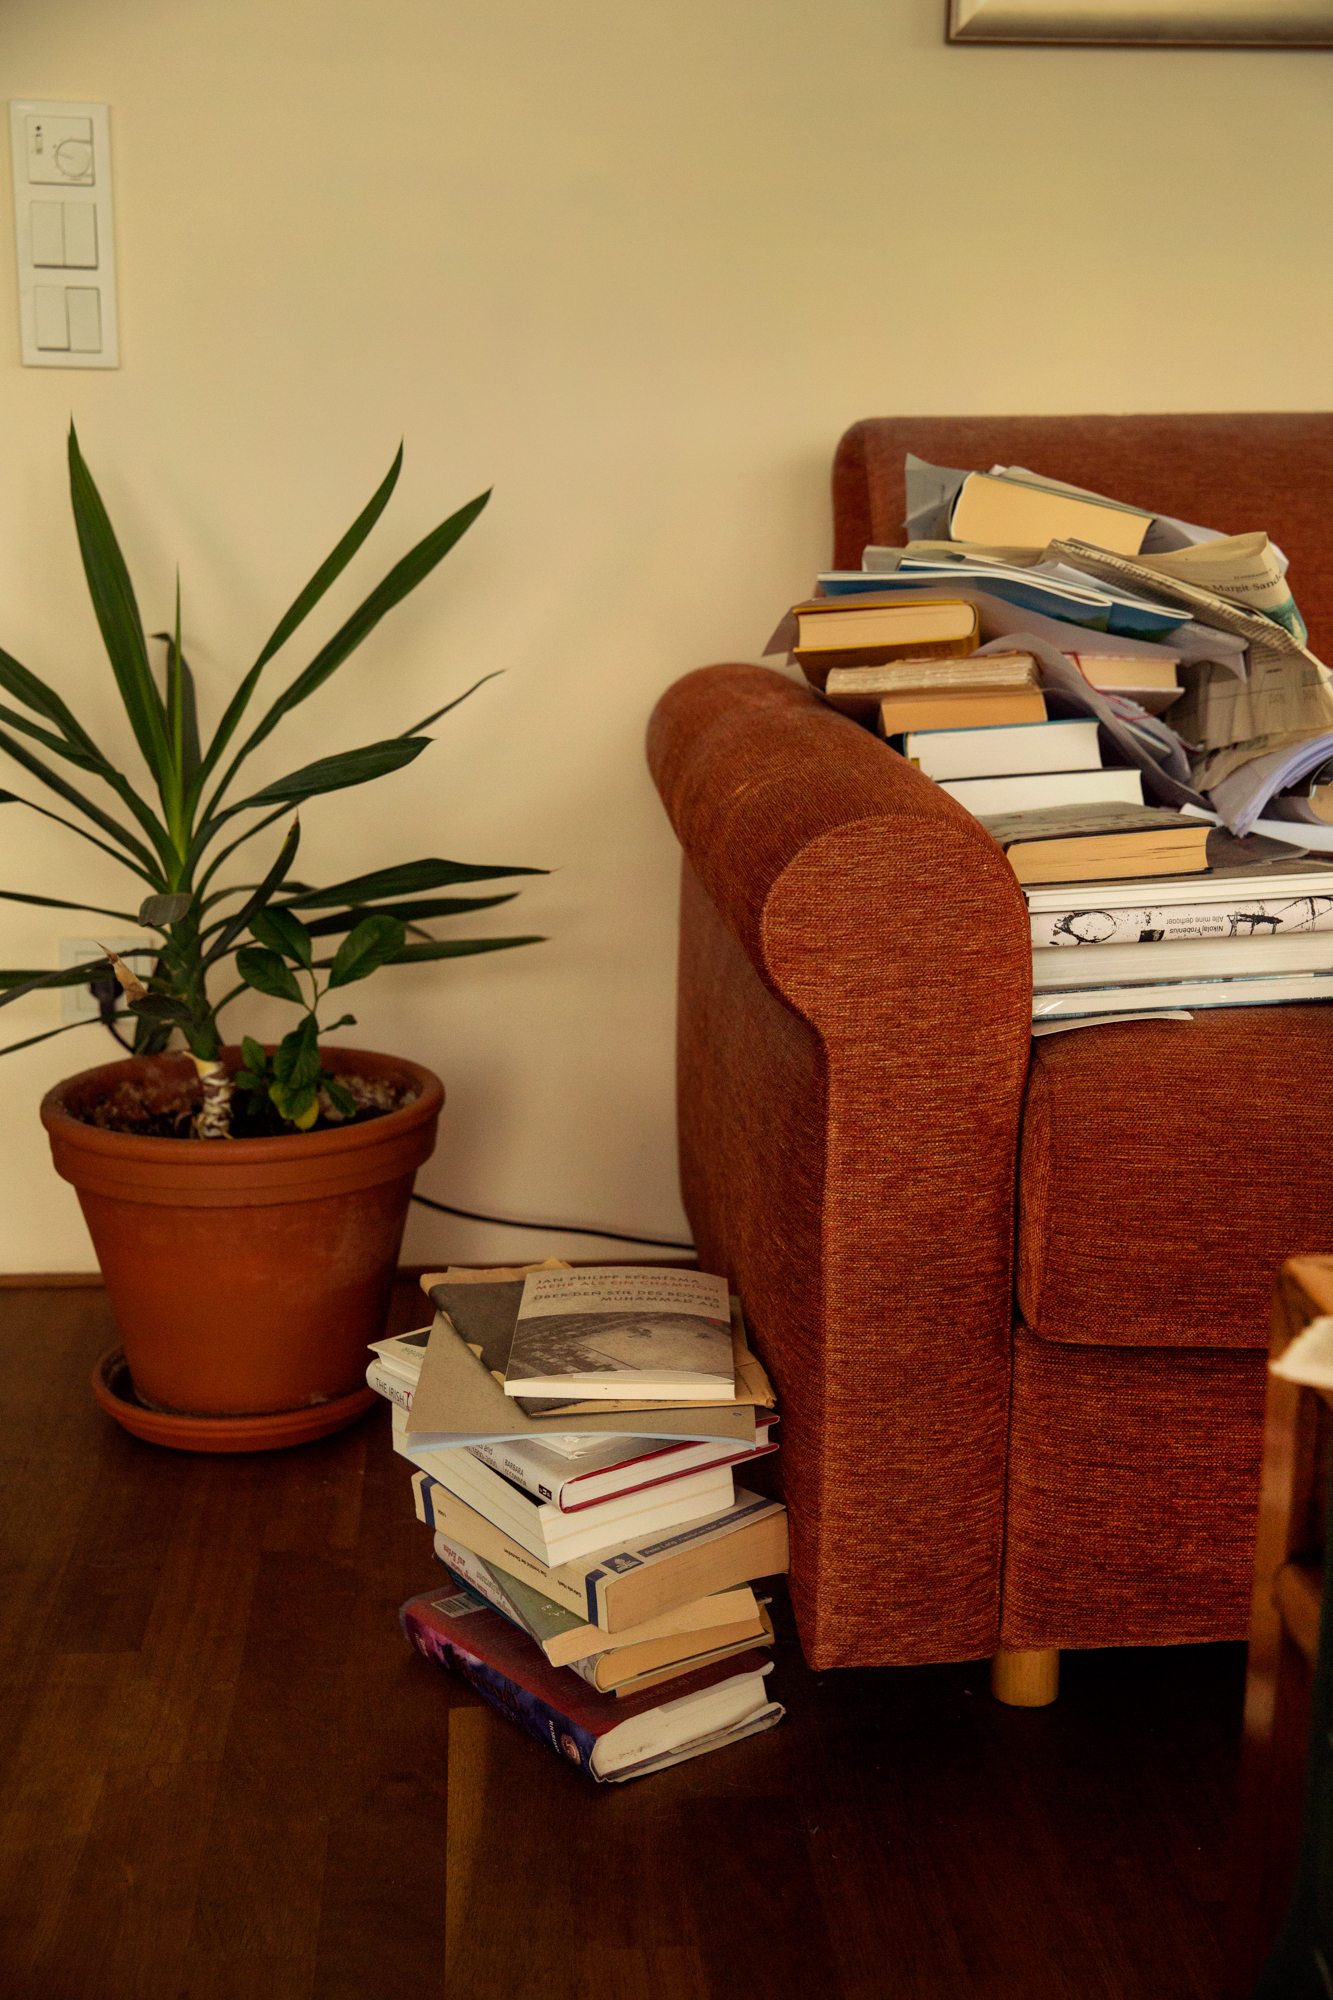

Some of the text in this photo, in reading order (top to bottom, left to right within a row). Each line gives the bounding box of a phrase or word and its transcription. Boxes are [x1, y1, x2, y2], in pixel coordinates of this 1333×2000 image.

[1212, 583, 1250, 594] Margit
[1194, 915, 1211, 923] mine
[1211, 915, 1224, 923] Alle
[1169, 925, 1224, 934] Nikolaj Frobenius
[537, 1273, 700, 1285] JAN PHILIPP REEMTSMA
[535, 1281, 575, 1291] MEHR
[639, 1280, 720, 1294] CHAMPION
[599, 1296, 721, 1310] MUHAMMAD ALI
[667, 1291, 720, 1304] BOXERS
[375, 1377, 388, 1394] THE
[388, 1385, 405, 1406] IRISH
[504, 1458, 524, 1478] BARBARA
[643, 1545, 661, 1556] Peter
[660, 1540, 678, 1553] Lang
